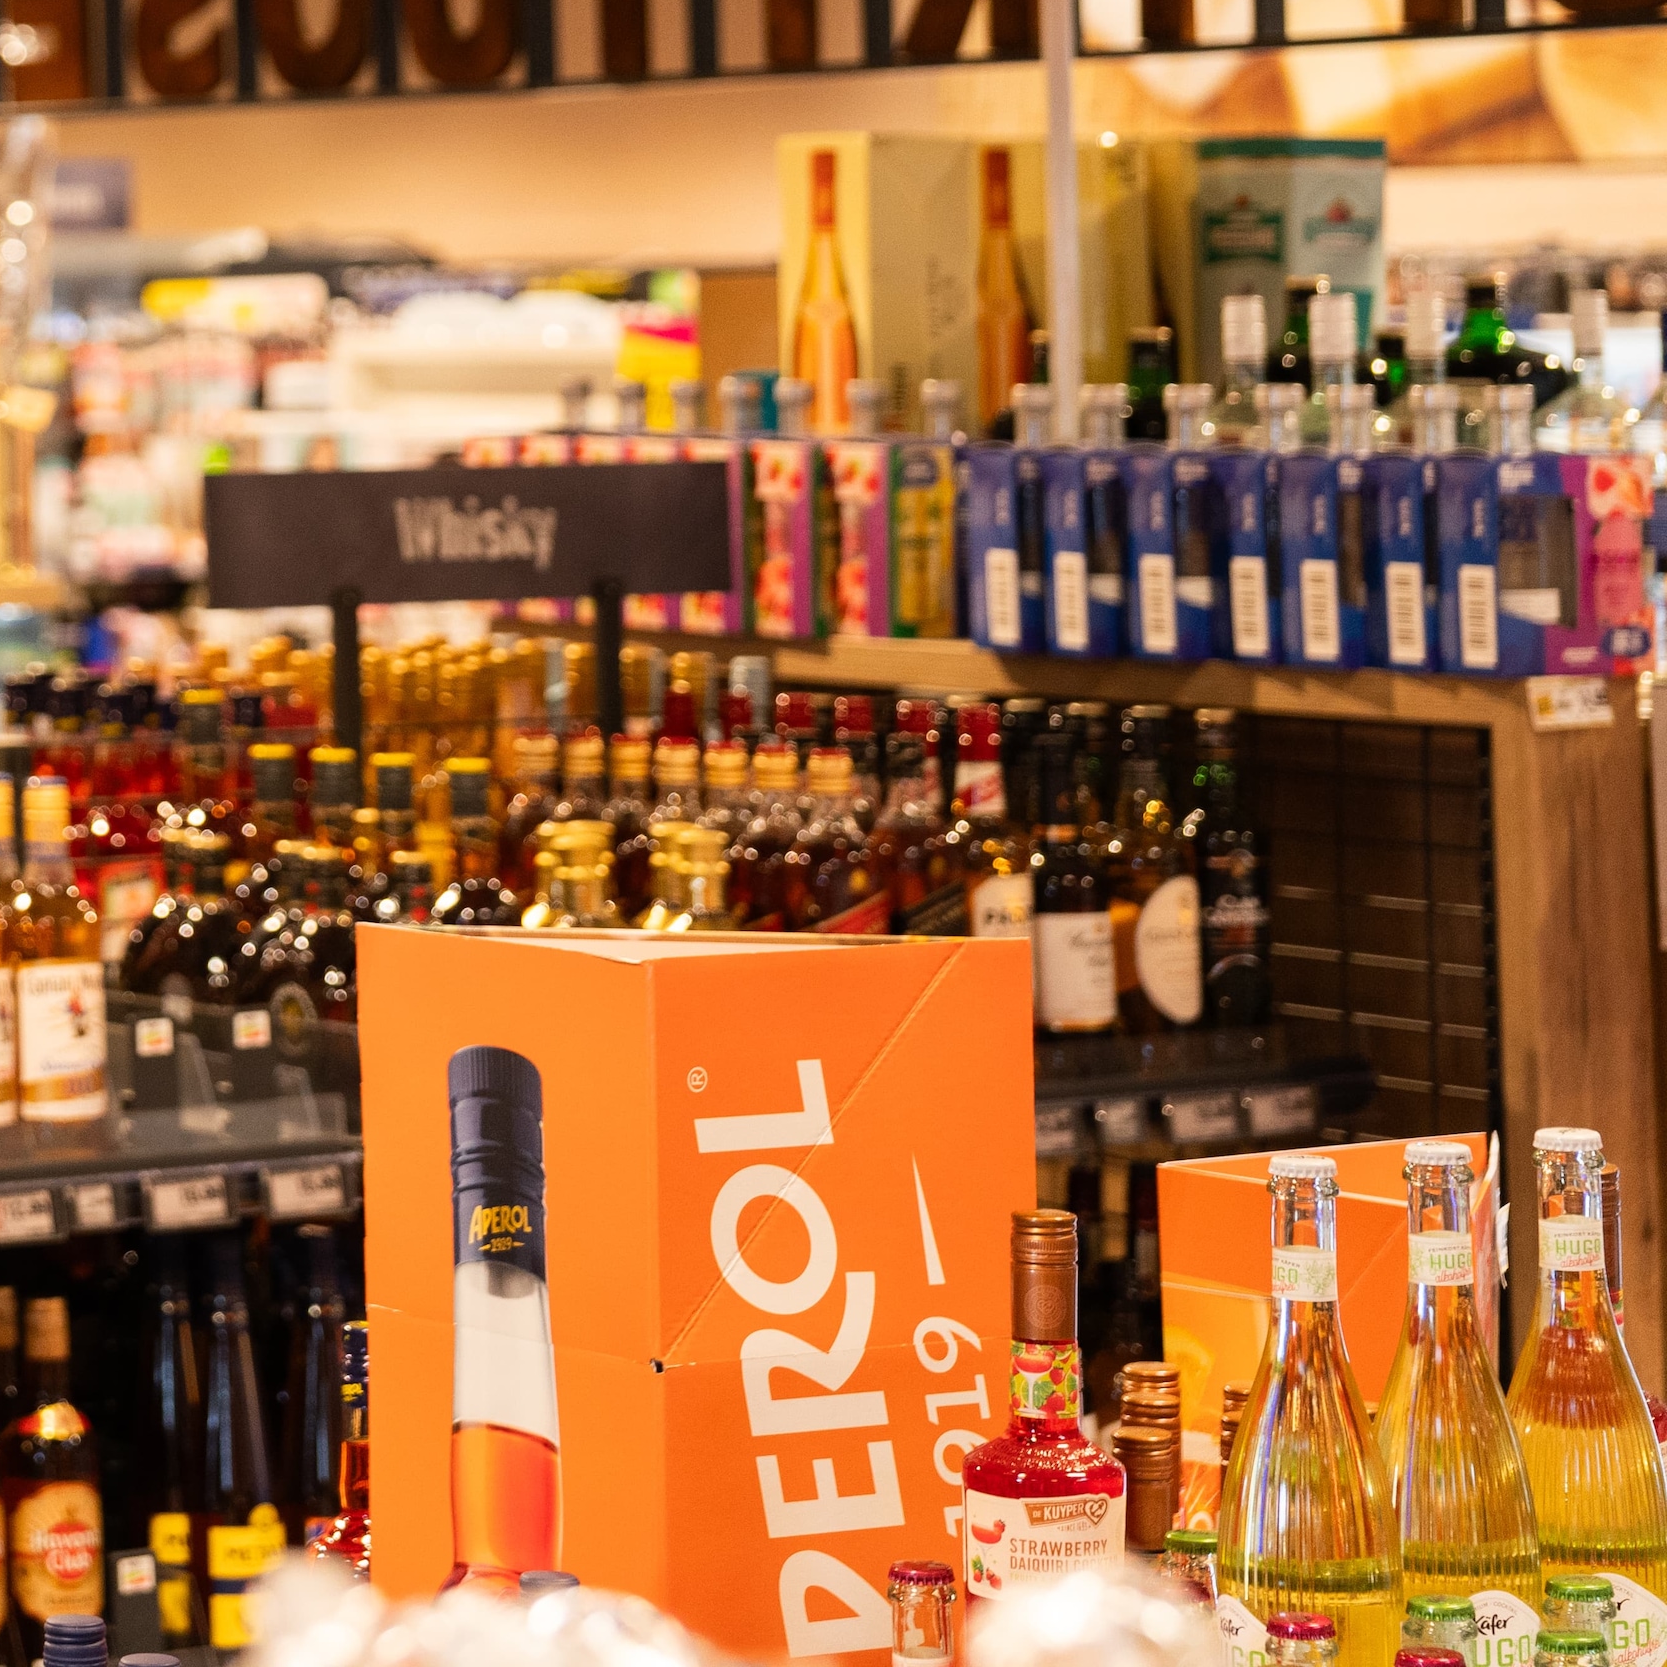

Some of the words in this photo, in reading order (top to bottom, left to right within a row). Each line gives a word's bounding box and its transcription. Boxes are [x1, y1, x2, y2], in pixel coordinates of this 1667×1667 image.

[393, 495, 557, 572] Whisky
[468, 1205, 533, 1244] APEROL
[694, 1059, 906, 1659] PEROL
[1043, 1503, 1085, 1521] KUYPER
[1009, 1537, 1108, 1558] STRAWBERRY
[1473, 1614, 1514, 1636] Käfer
[1612, 1618, 1650, 1649] GO
[1471, 1634, 1531, 1667] UGO
